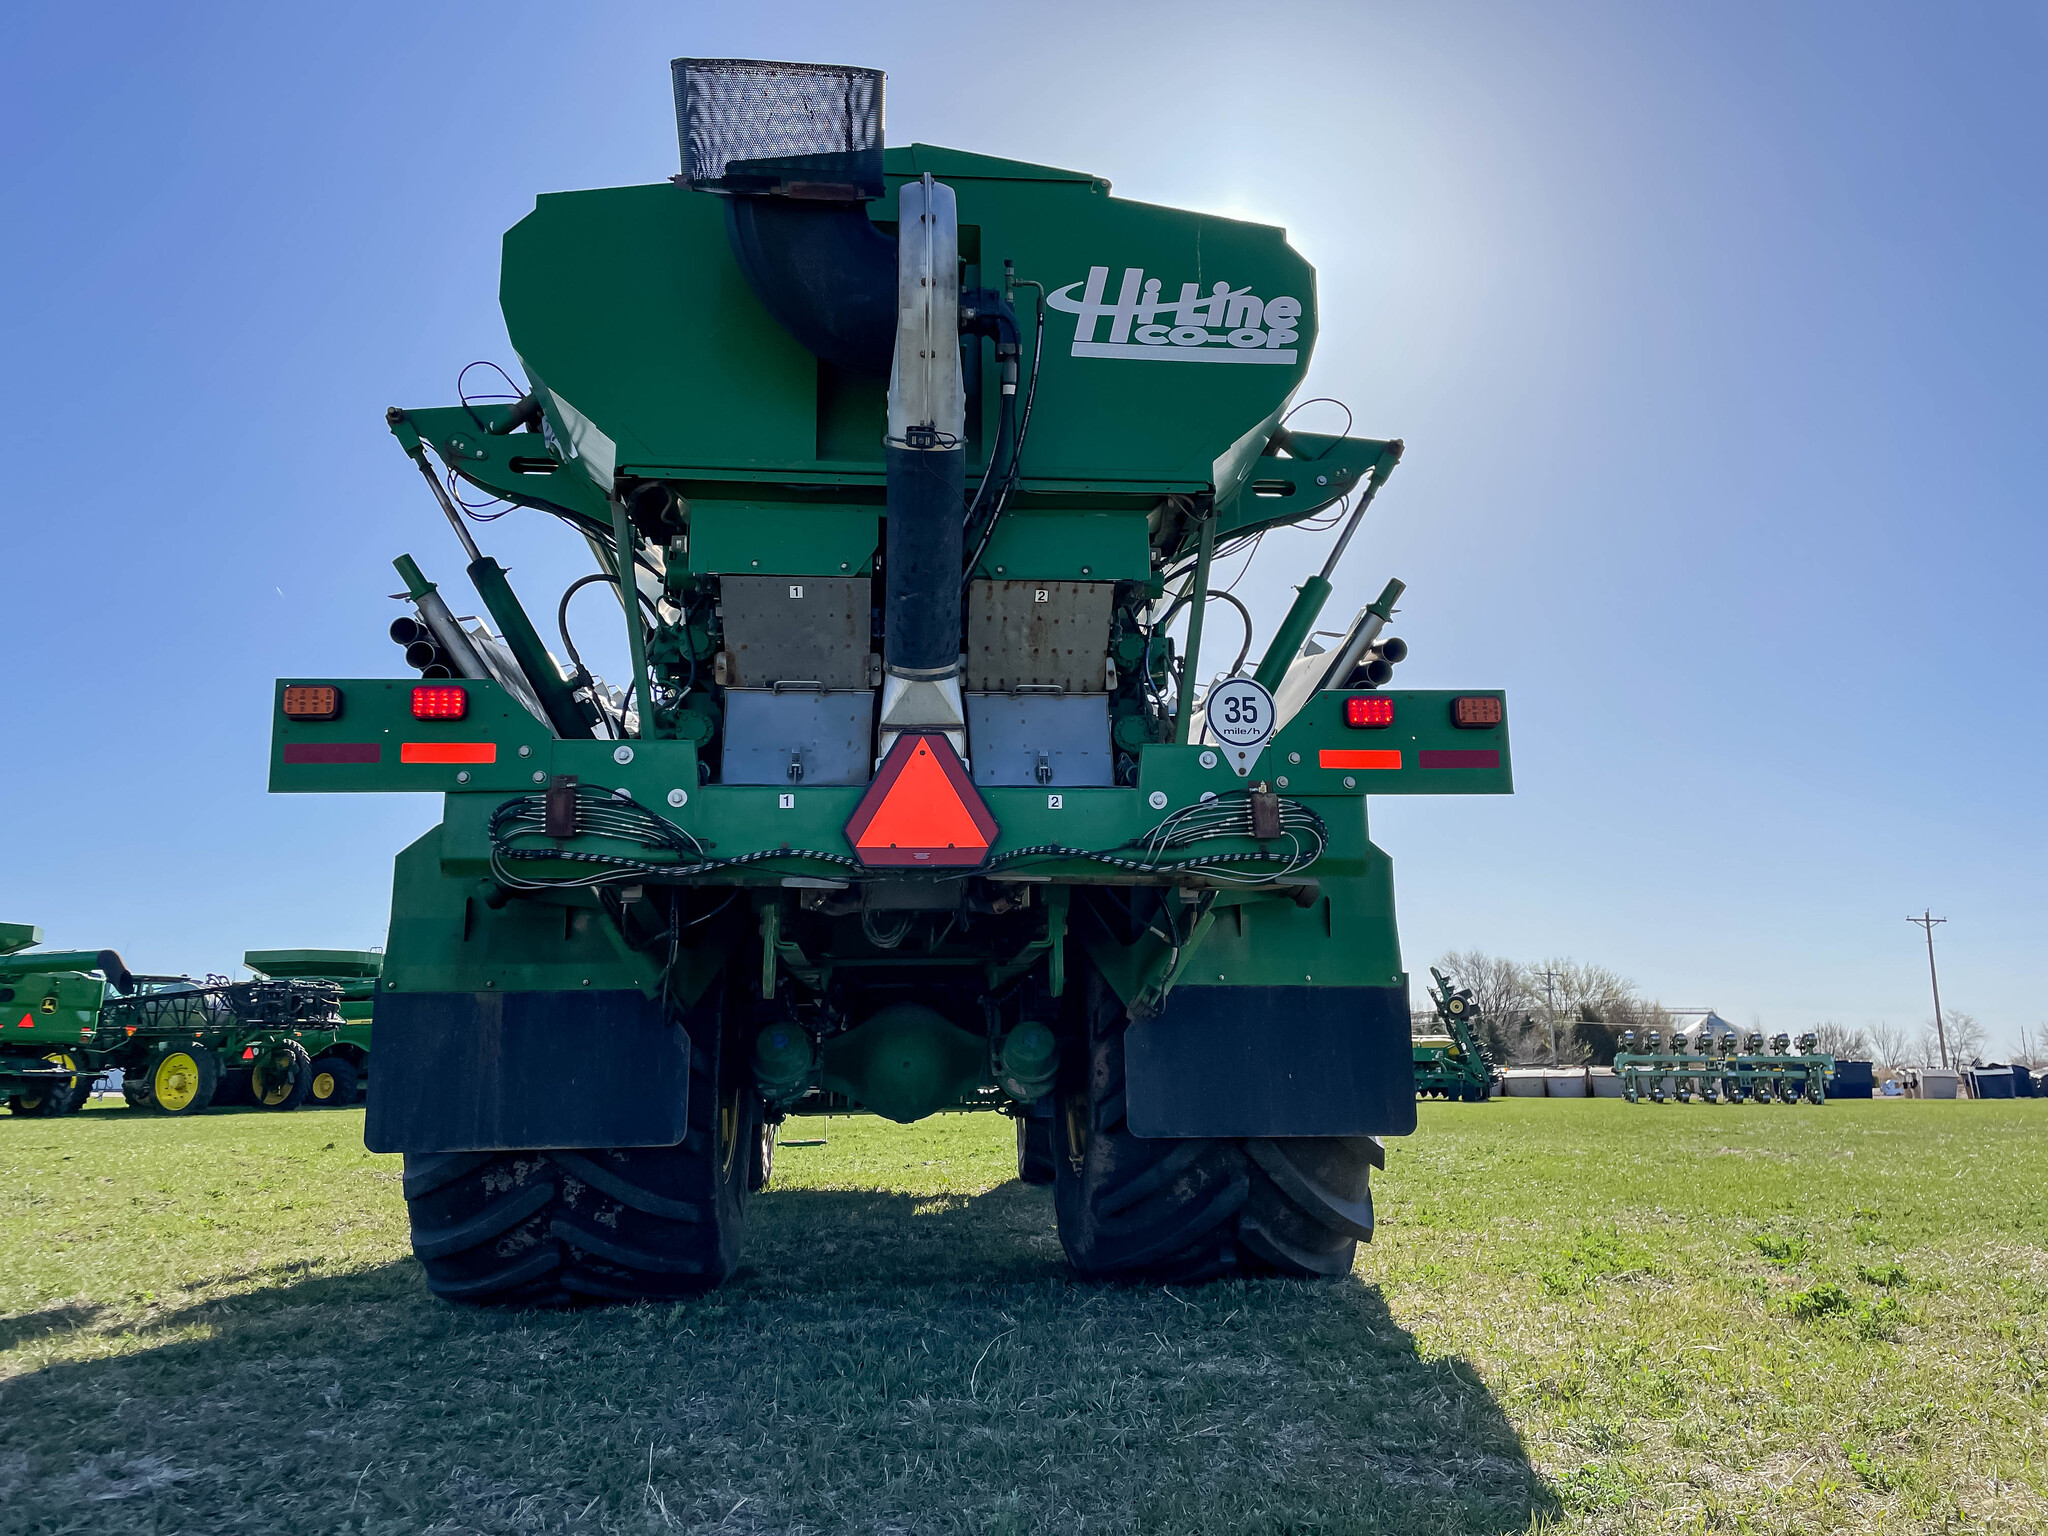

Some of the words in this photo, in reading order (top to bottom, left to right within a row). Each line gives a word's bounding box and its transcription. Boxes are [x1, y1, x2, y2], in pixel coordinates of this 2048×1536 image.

[1037, 590, 1046, 601] 2
[1224, 696, 1258, 724] 35
[1223, 727, 1261, 735] mile/h
[1050, 796, 1059, 808] 2
